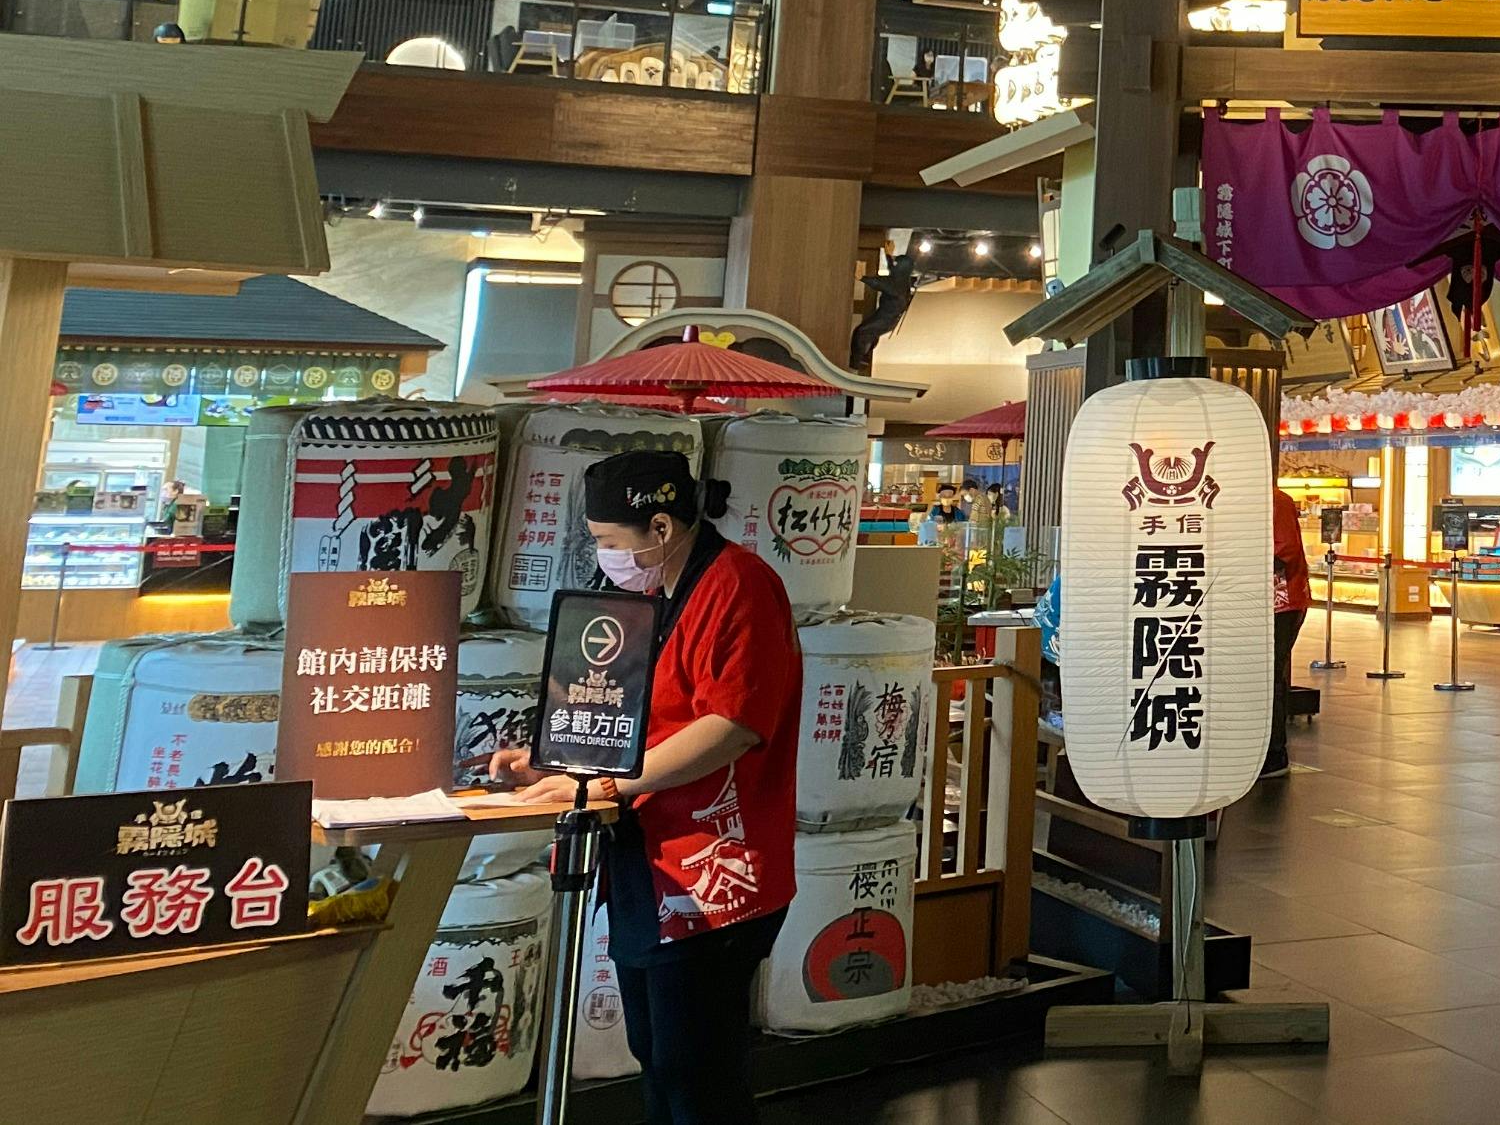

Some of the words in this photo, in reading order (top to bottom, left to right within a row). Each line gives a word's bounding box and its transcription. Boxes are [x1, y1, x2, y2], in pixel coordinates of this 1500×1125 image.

[1139, 514, 1204, 535] 手信
[297, 644, 448, 676] 館內請保持
[310, 682, 431, 715] 社交距離
[550, 708, 635, 737] 參觀方向
[550, 733, 586, 745] VISITING
[587, 736, 631, 748] DIRECTION
[16, 857, 289, 946] 服務台
